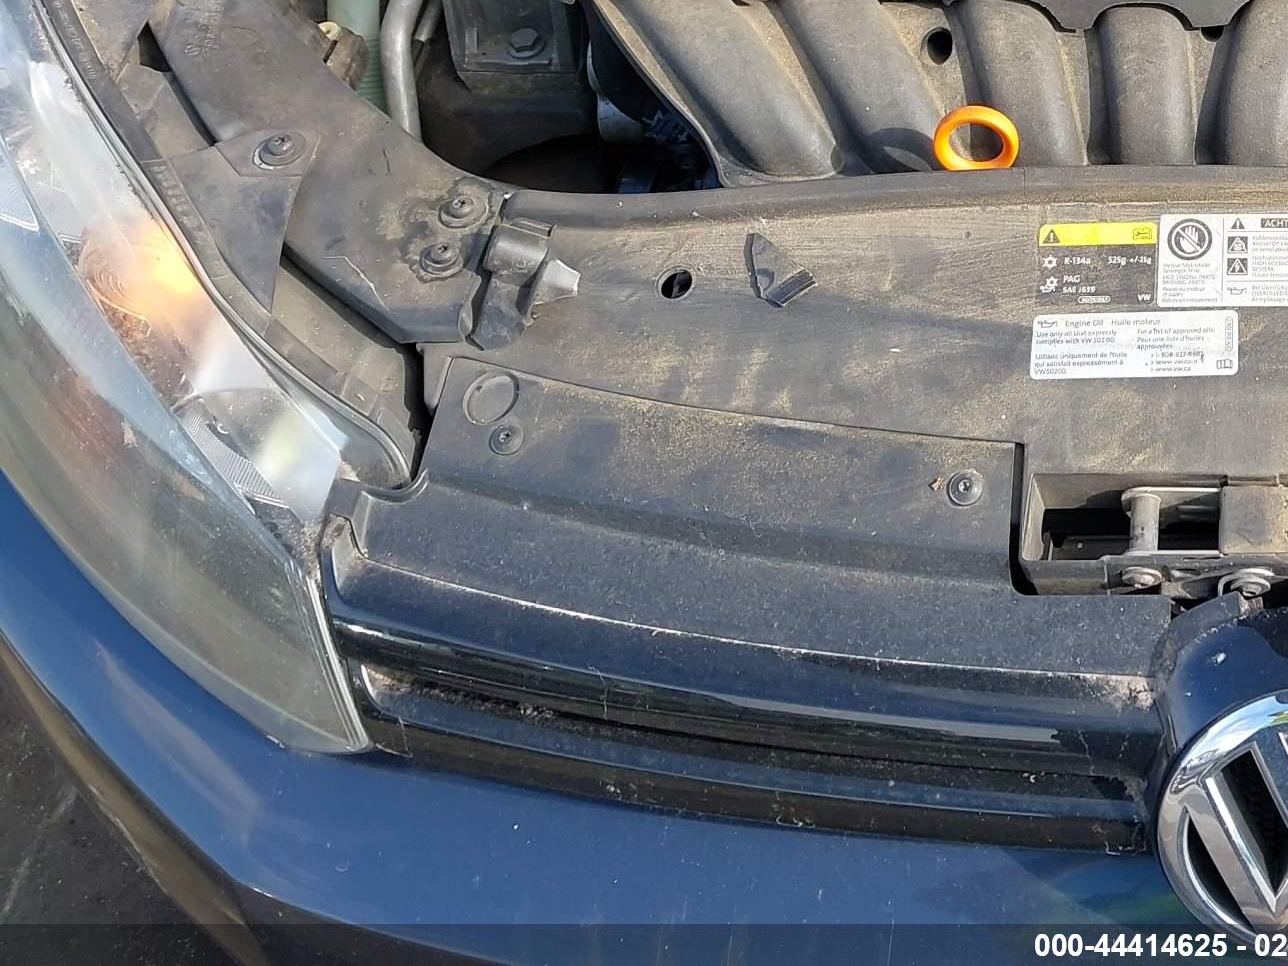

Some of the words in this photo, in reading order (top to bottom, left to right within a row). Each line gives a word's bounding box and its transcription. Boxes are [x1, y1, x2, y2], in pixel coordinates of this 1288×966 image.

[1064, 256, 1091, 265] R-134a
[1063, 275, 1081, 283] PAG
[1065, 320, 1091, 329] Engine
[1112, 318, 1131, 326] Huile
[1133, 318, 1161, 326] moteur
[1050, 331, 1062, 339] only
[1172, 327, 1201, 336] approved
